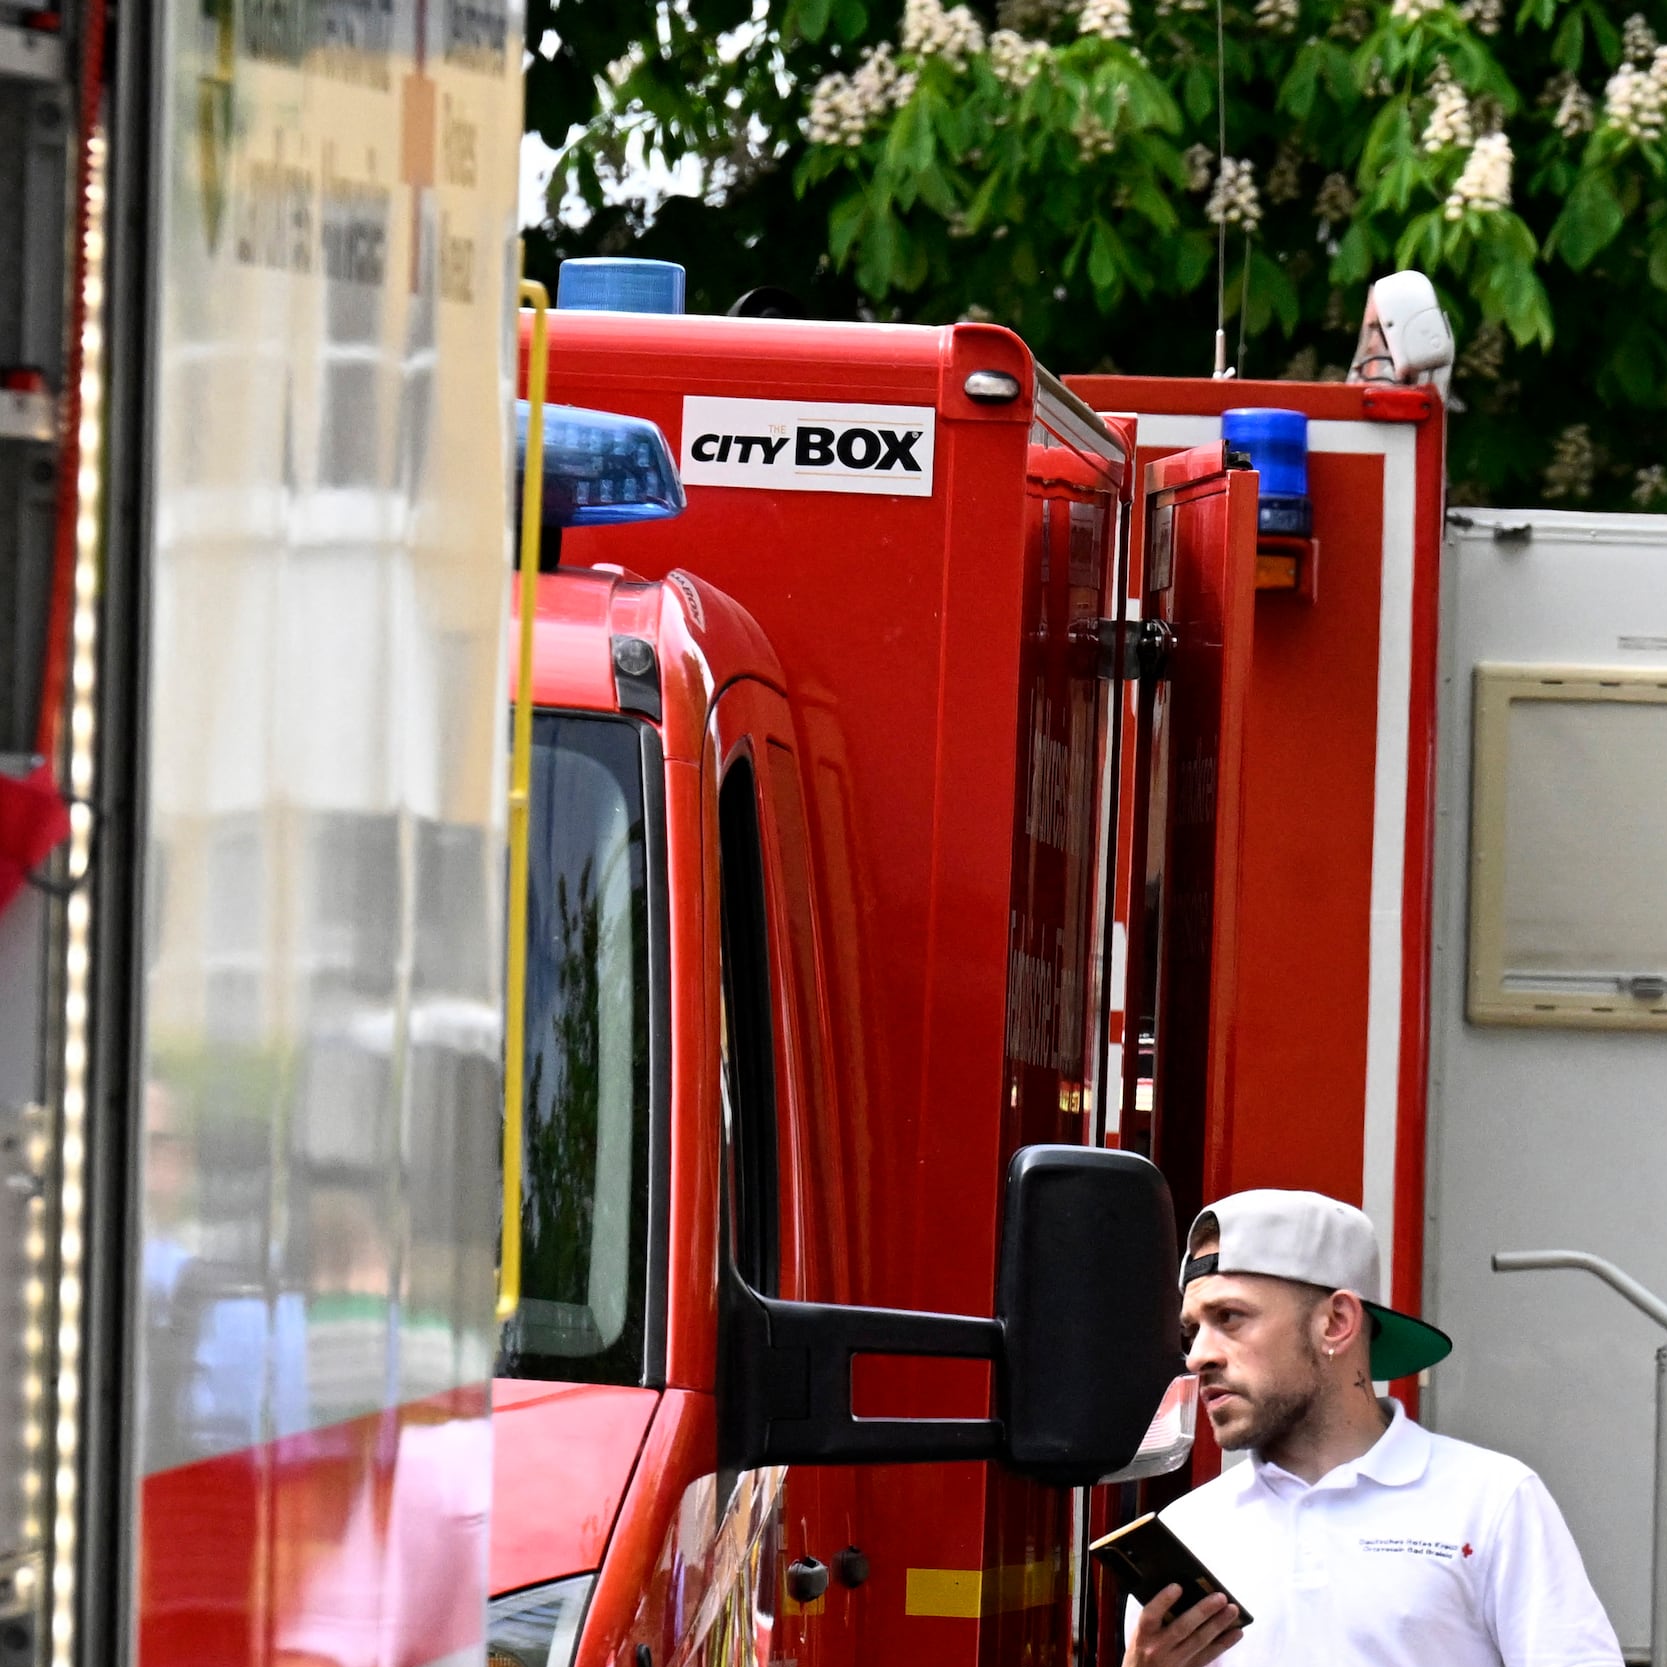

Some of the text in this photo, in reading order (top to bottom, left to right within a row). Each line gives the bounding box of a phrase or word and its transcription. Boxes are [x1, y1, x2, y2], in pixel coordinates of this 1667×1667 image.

[768, 424, 786, 434] THE
[691, 426, 923, 472] CITY BOX
